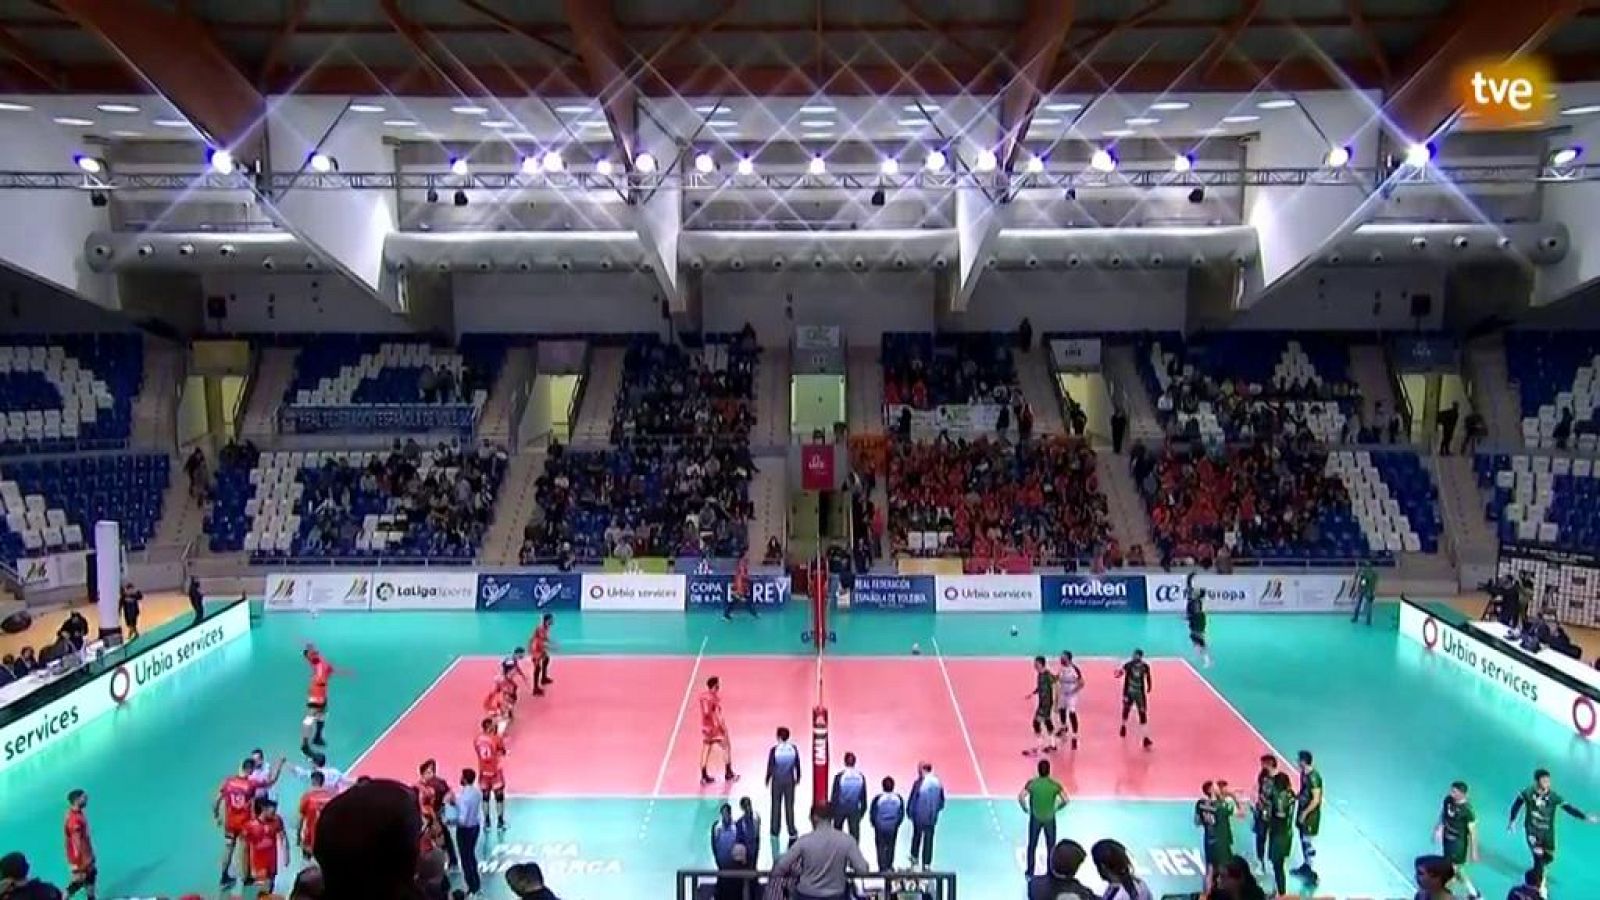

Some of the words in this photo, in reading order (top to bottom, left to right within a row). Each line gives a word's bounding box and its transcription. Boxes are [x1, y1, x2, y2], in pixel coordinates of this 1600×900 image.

[606, 587, 635, 599] Urbia
[638, 588, 677, 599] services
[690, 582, 722, 593] COPA
[752, 582, 787, 603] REY
[961, 588, 990, 599] Urbia
[992, 588, 1032, 599] services
[1062, 580, 1127, 597] molten
[135, 651, 174, 686] Urbia
[177, 624, 224, 664] services
[1441, 628, 1477, 668] Urbia
[1480, 655, 1538, 702] services
[4, 704, 79, 761] services
[1152, 848, 1205, 876] REY
